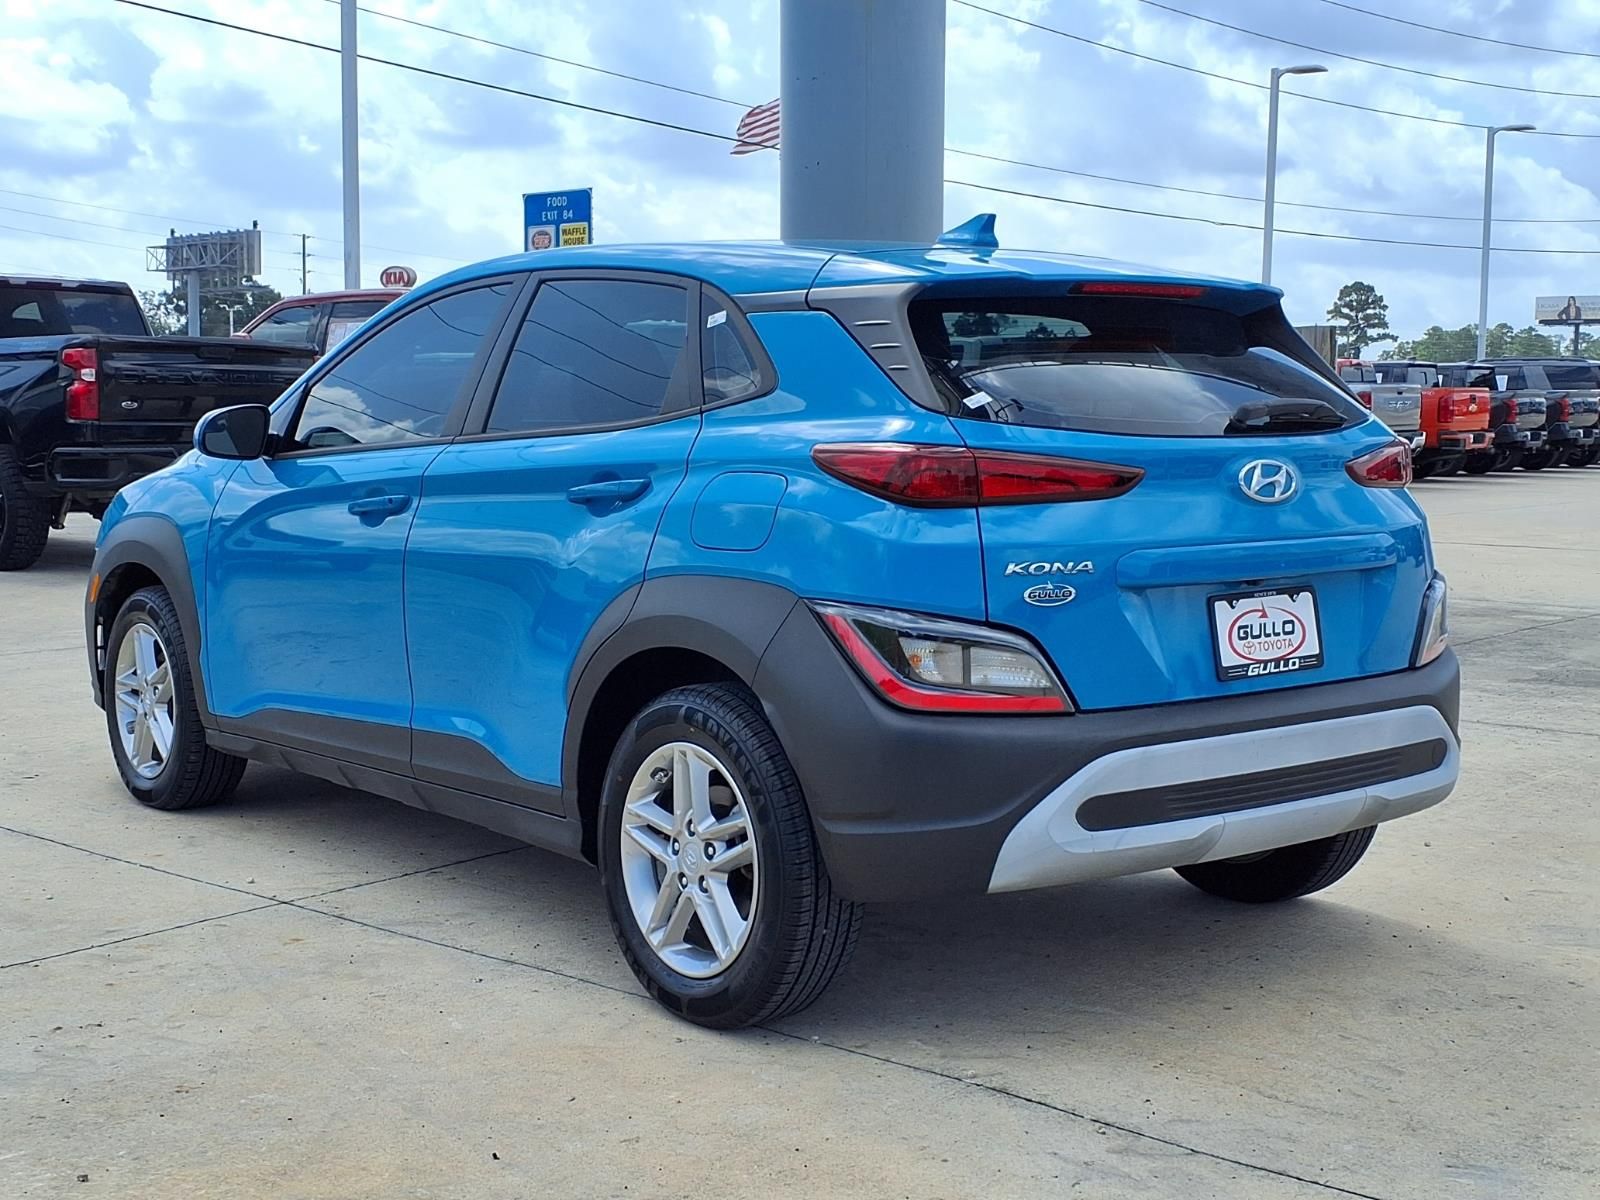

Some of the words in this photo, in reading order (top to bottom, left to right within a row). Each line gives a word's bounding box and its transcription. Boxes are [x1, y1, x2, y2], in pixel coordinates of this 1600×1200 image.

[546, 196, 568, 207] FOOD
[542, 210, 558, 221] EXIT
[562, 209, 573, 220] 84
[561, 226, 586, 237] WAFFLE
[563, 236, 585, 246] HOUSE
[385, 271, 405, 285] KIA
[1004, 560, 1095, 576] KONA
[1027, 588, 1073, 600] GULLO
[1237, 619, 1295, 641] GULLO
[1258, 638, 1294, 652] TOYOTA
[1247, 658, 1300, 676] GULLO
